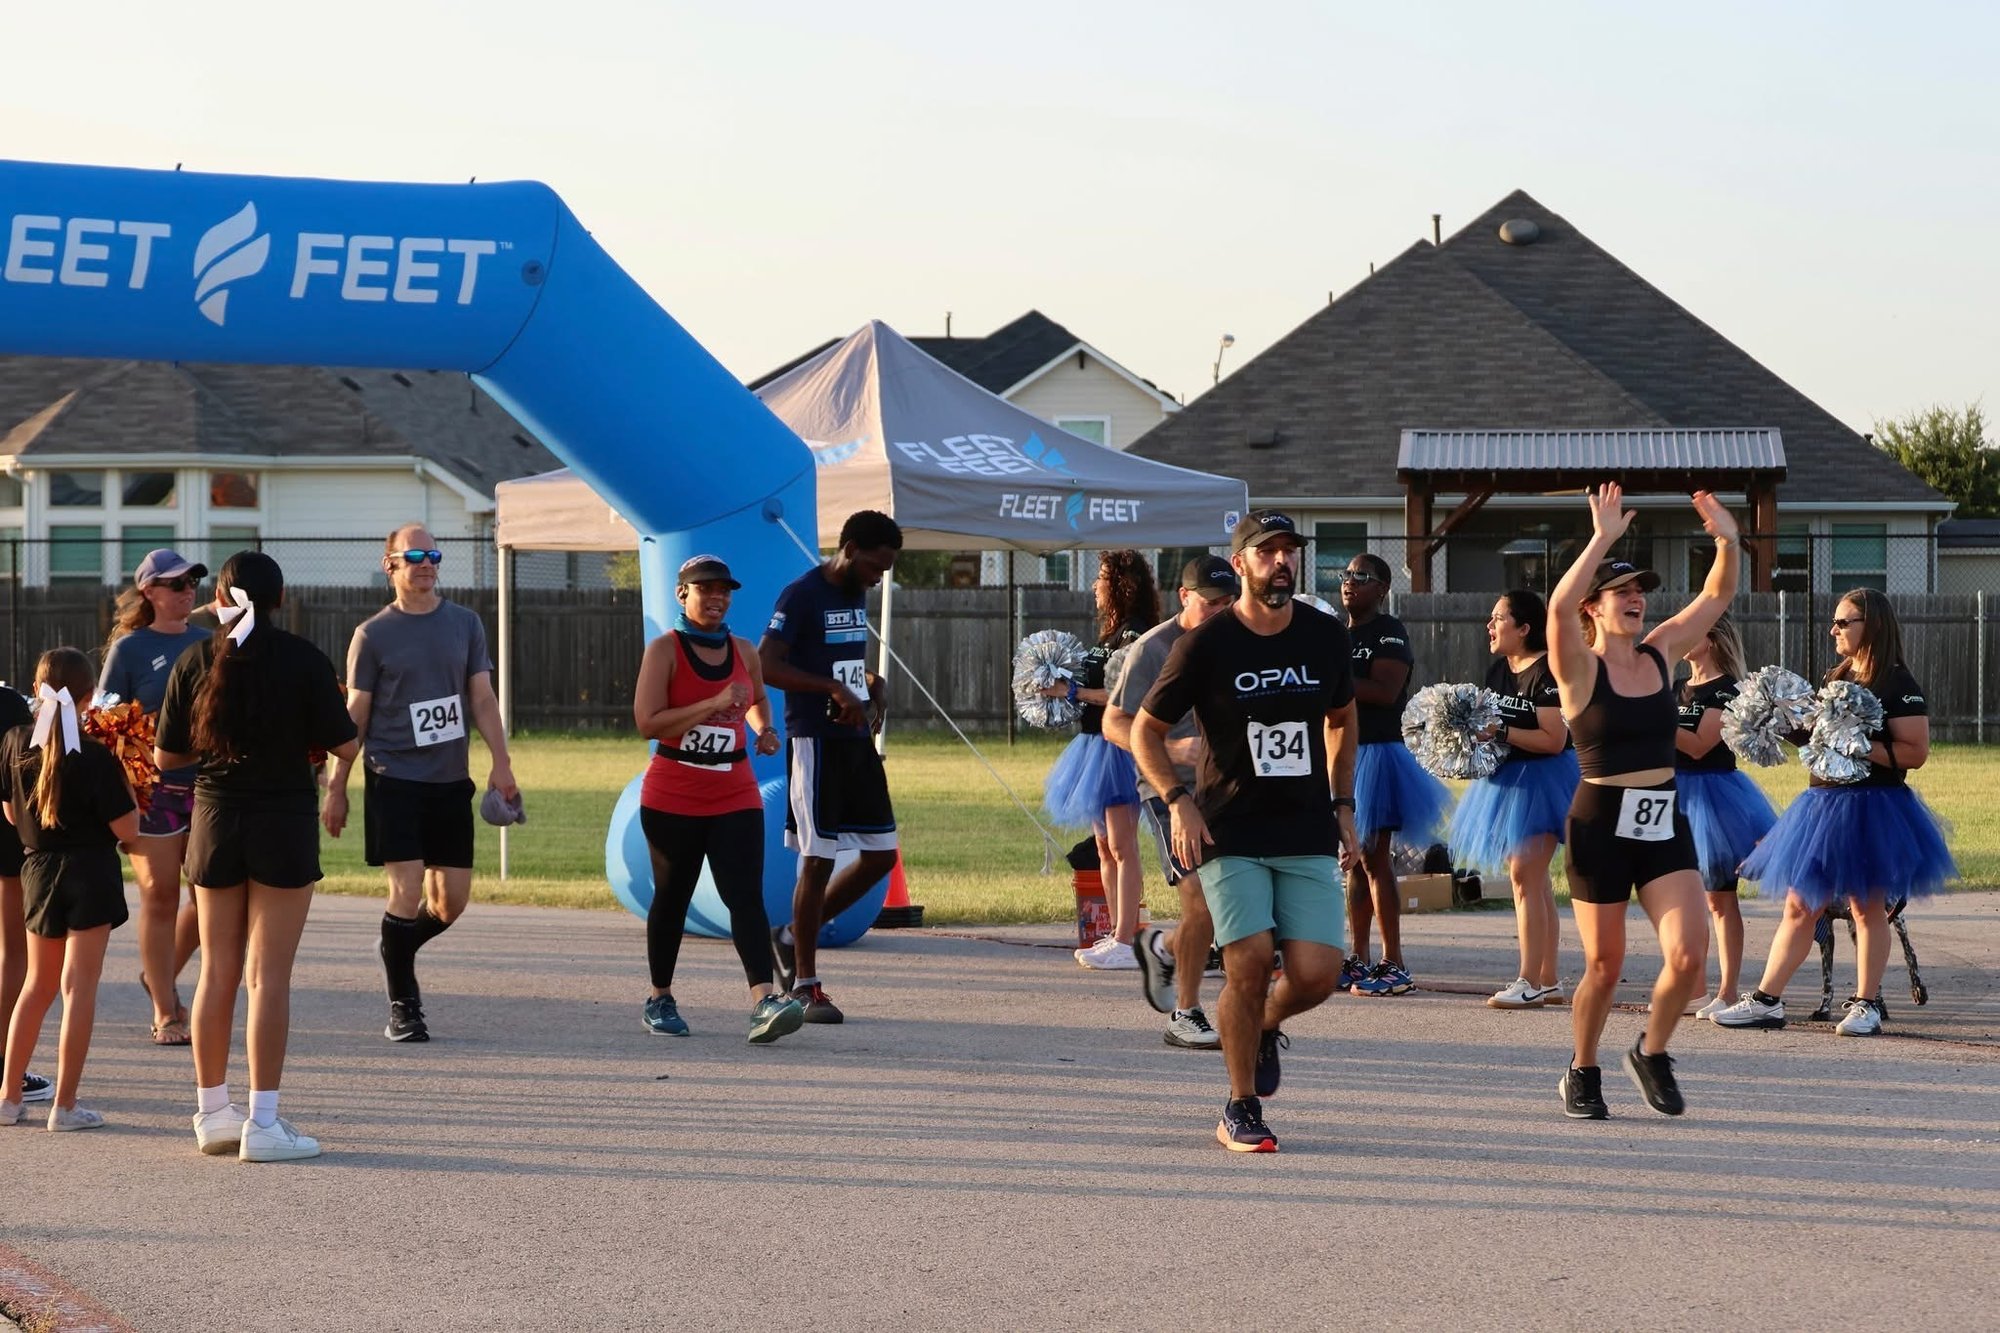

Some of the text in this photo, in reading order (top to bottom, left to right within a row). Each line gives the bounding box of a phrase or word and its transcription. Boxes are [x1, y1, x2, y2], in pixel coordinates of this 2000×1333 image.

[2, 214, 171, 289] EET
[290, 232, 496, 305] FEET
[893, 434, 1024, 463] FLEET
[999, 494, 1140, 522] FLEET FEET
[838, 666, 864, 688] 145
[1234, 665, 1320, 691] OPAL
[416, 702, 459, 732] 294
[685, 729, 731, 753] 347
[1253, 729, 1304, 760] 134
[1634, 797, 1669, 826] 87
